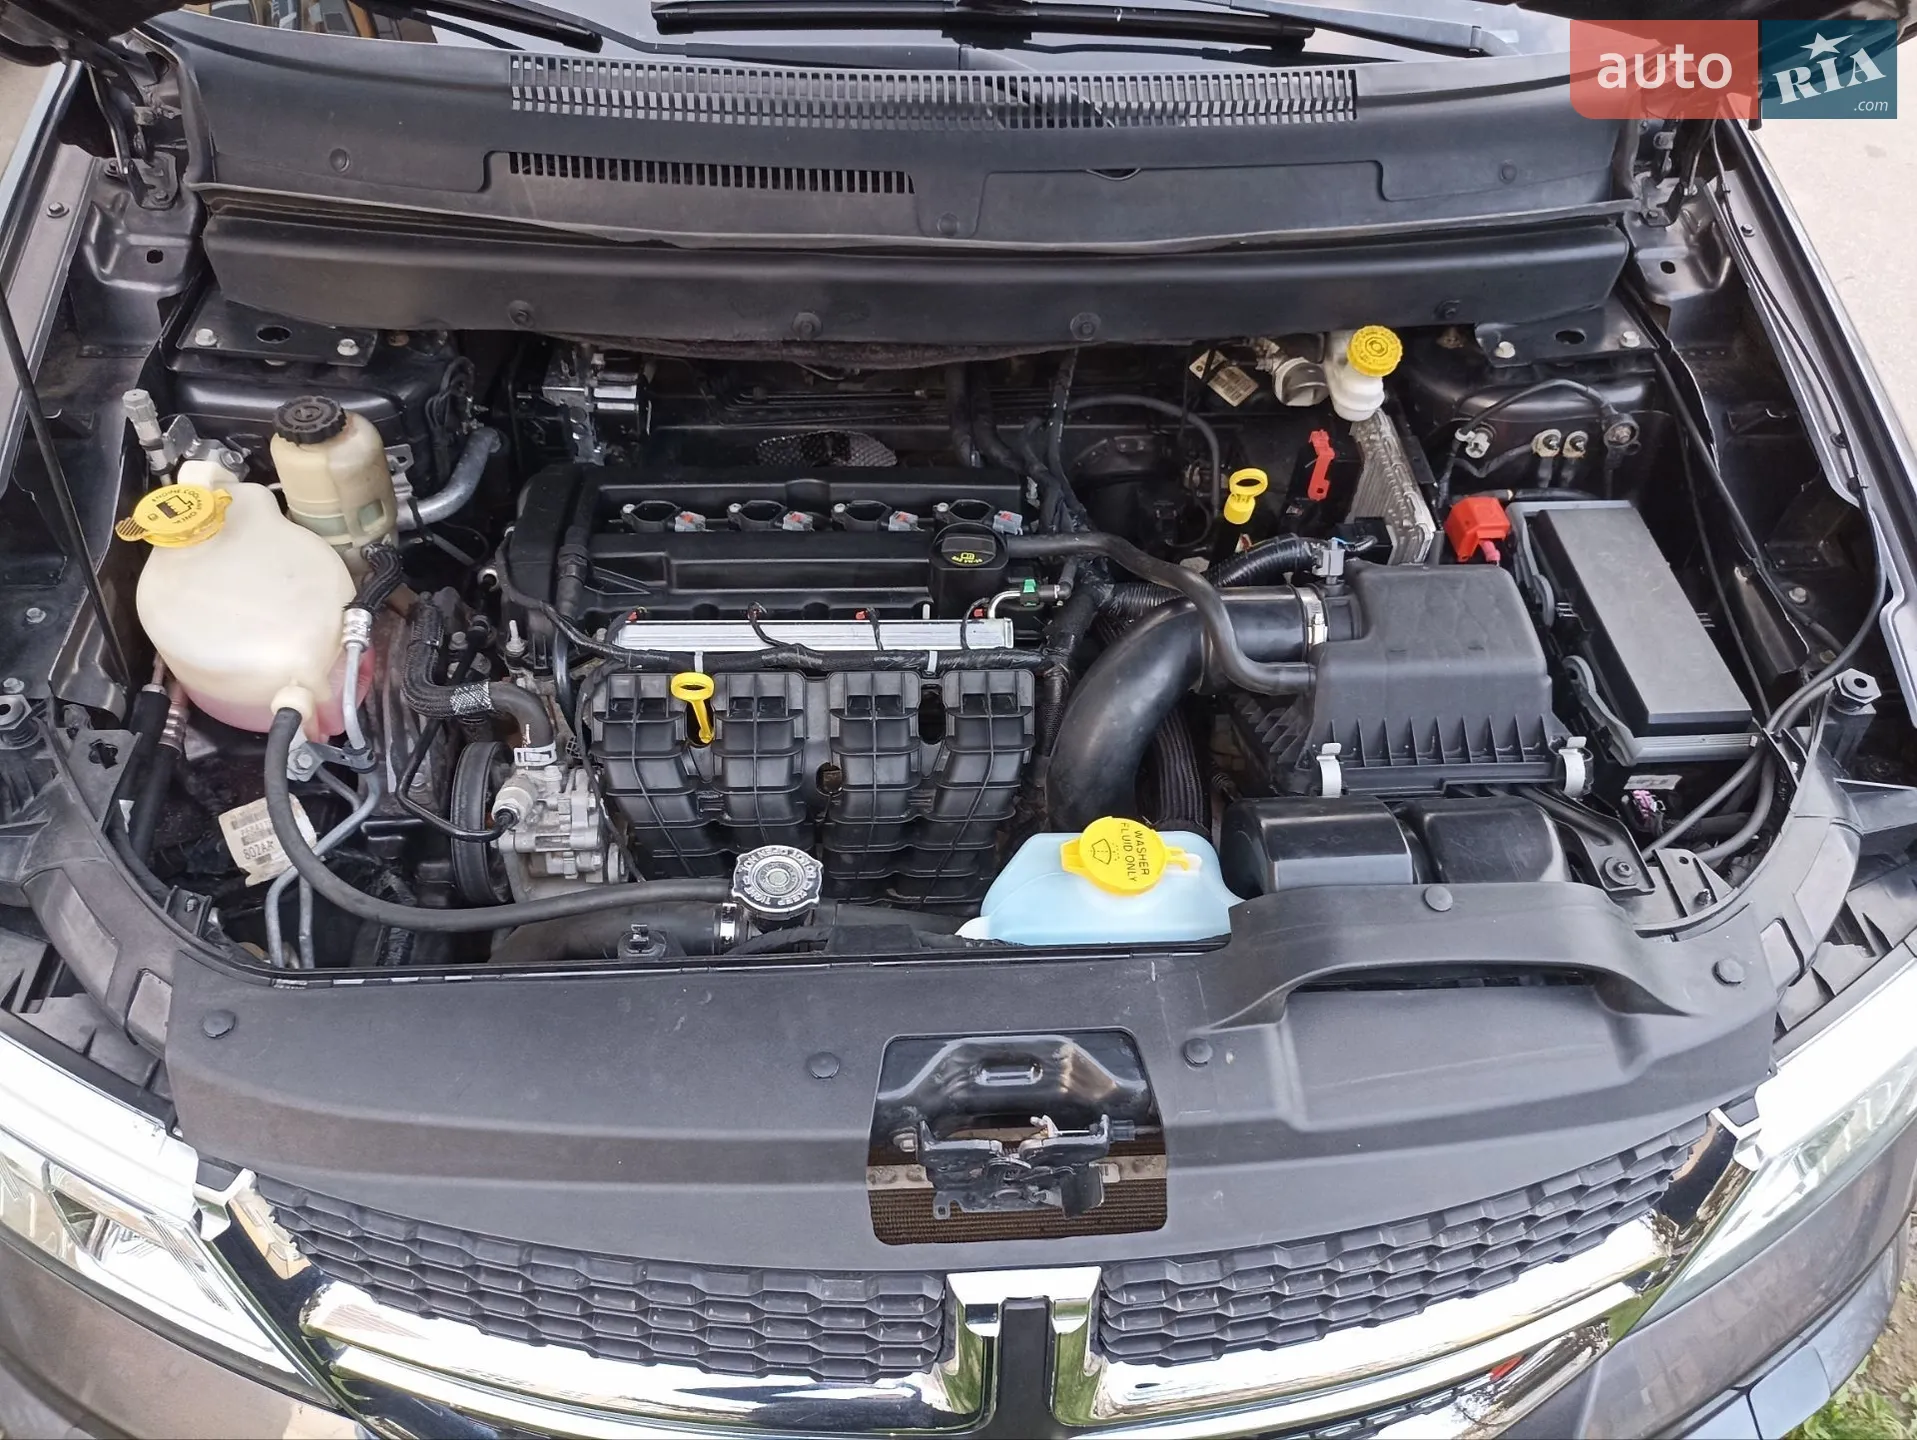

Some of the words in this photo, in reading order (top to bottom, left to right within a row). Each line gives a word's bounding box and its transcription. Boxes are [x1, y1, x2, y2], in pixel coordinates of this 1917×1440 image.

[1121, 822, 1133, 852] FLUID
[1134, 830, 1150, 876] WASHER
[1124, 855, 1137, 882] ONLY
[743, 887, 771, 905] TIGHT
[777, 889, 808, 906] KEEP
